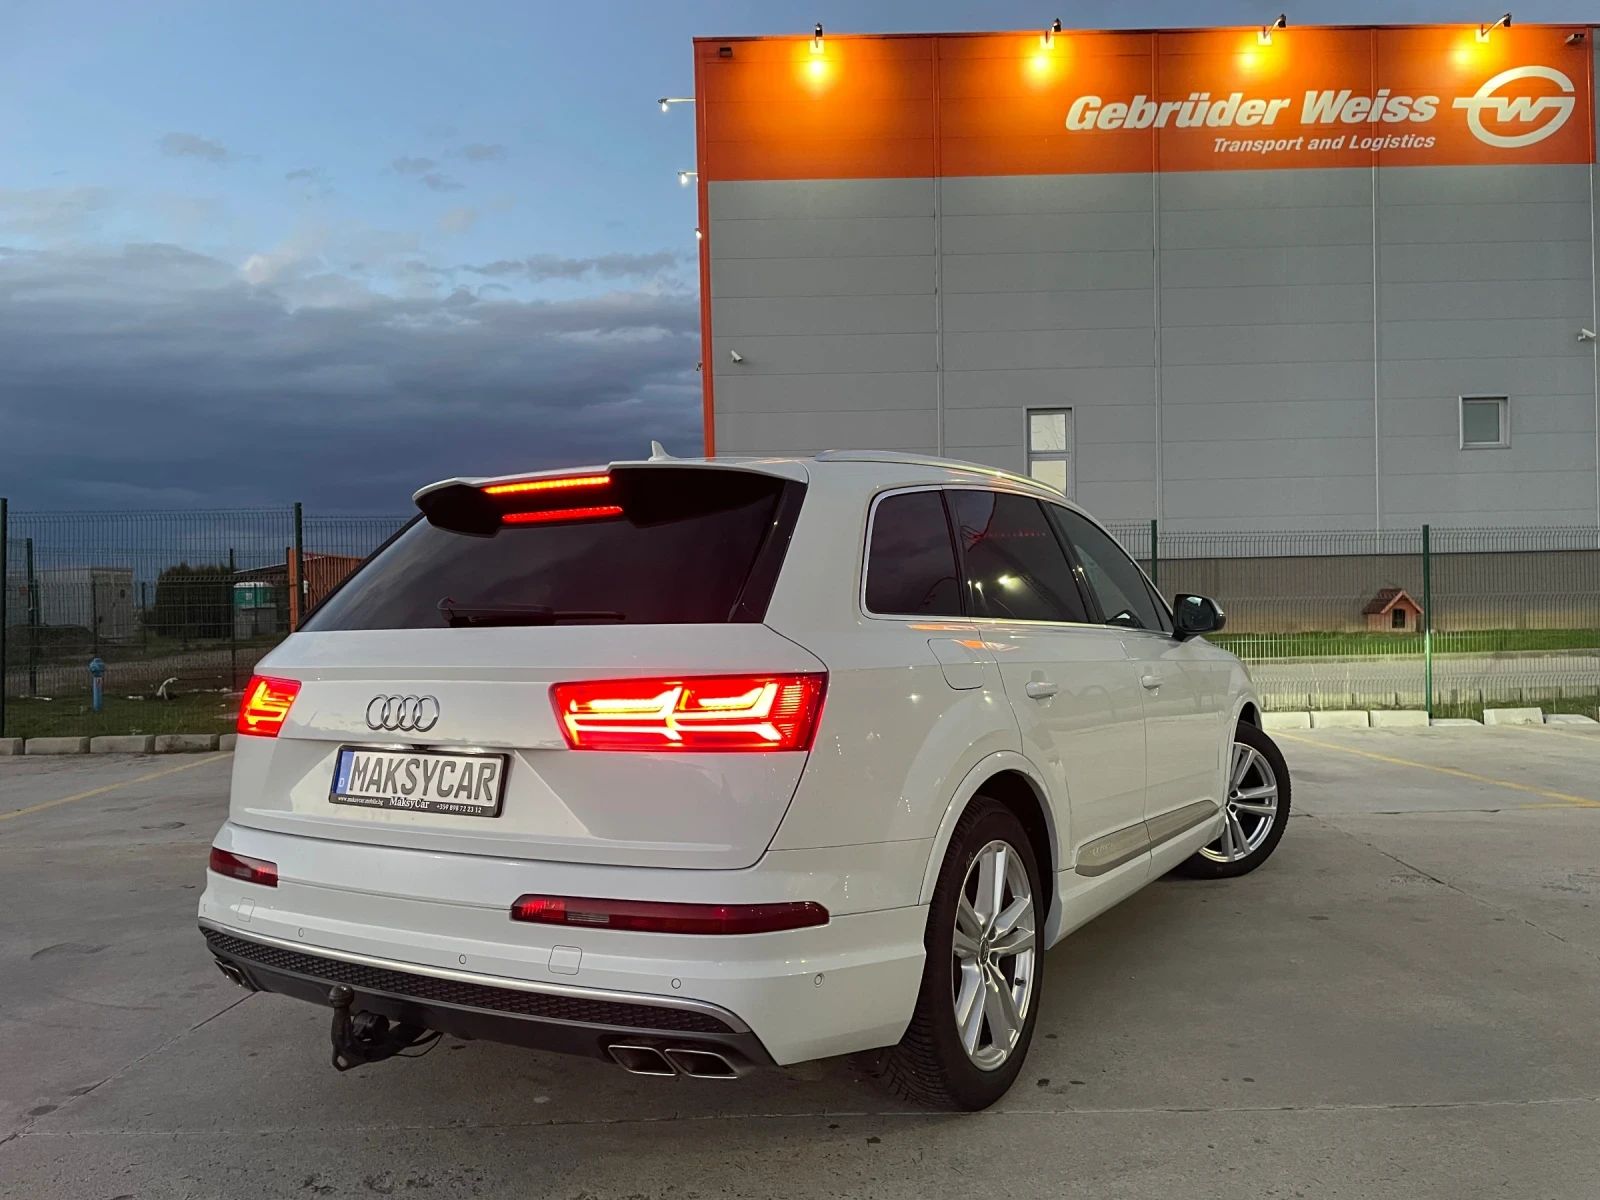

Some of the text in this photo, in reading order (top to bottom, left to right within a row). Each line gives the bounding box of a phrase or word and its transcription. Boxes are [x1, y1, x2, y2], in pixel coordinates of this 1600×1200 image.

[1065, 89, 1440, 131] Gebrüder Weiss
[1213, 133, 1437, 155] Transport and Logistics
[349, 755, 497, 801] MAKSYCAR
[388, 796, 430, 809] MaksyCar
